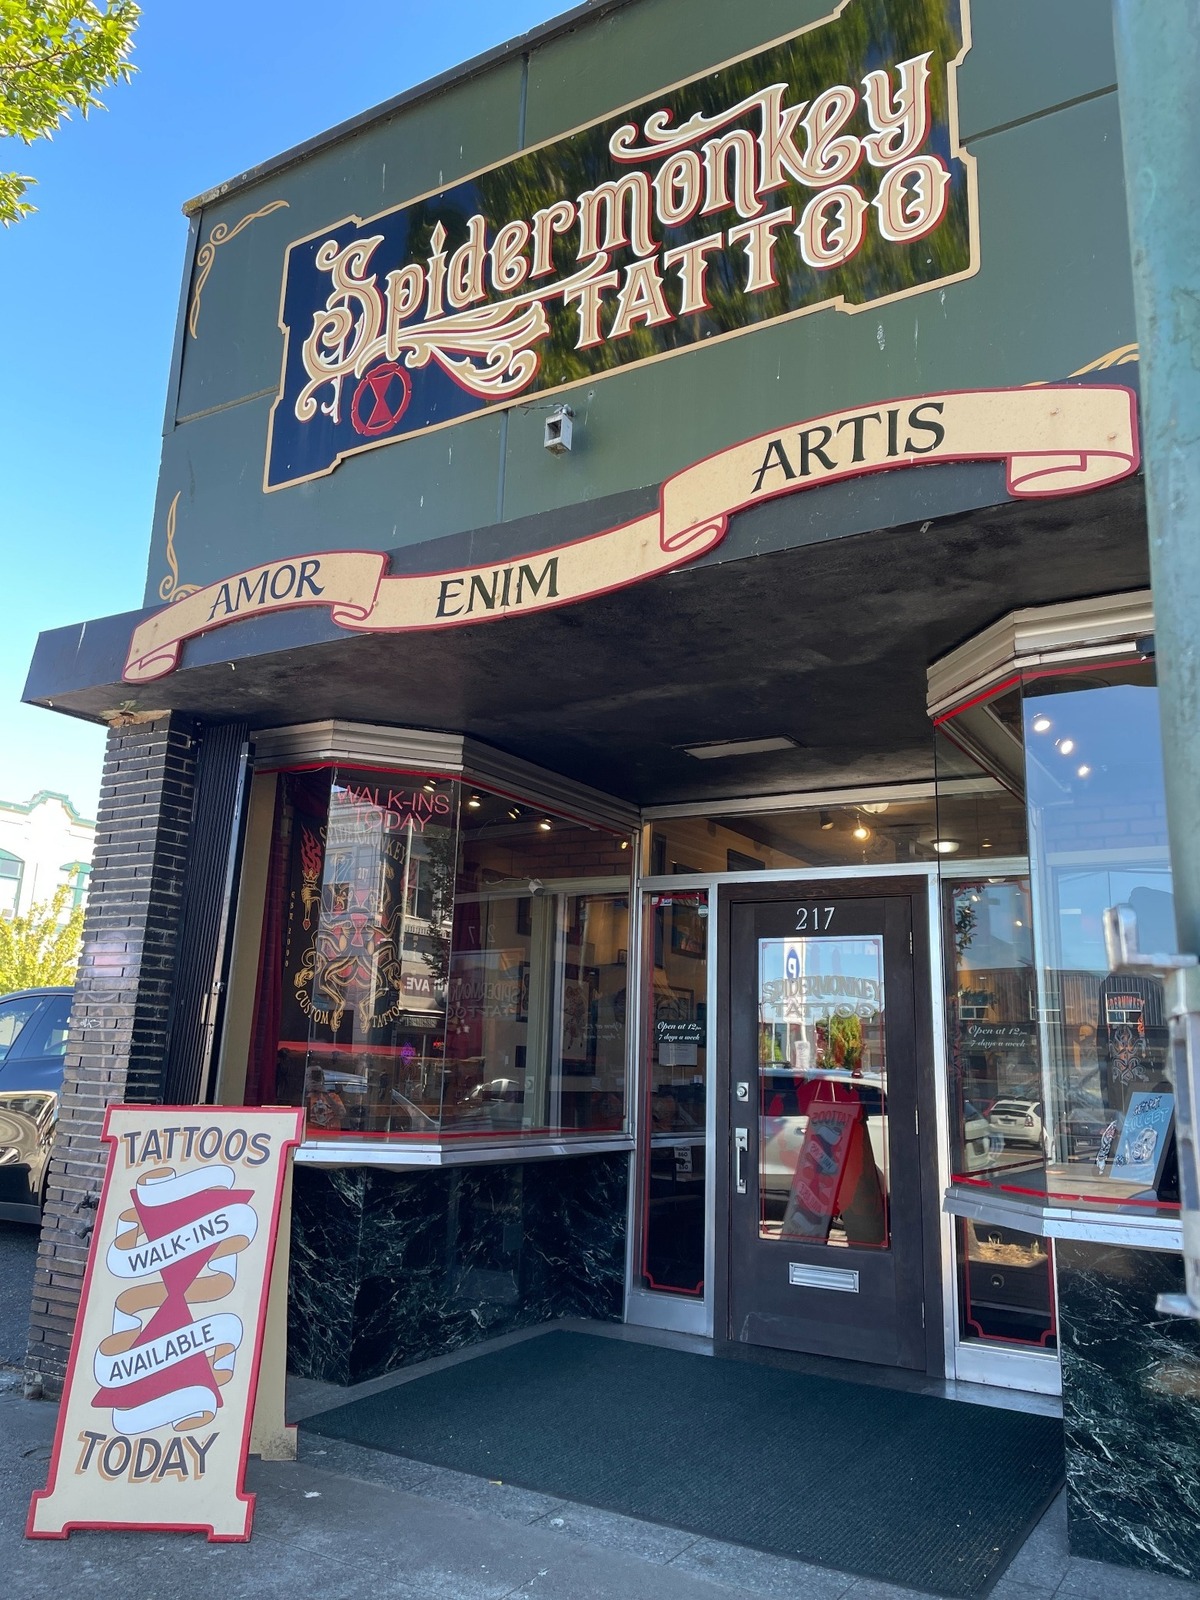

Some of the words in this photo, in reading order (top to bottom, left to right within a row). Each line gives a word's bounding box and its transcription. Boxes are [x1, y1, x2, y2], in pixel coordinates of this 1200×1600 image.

[293, 49, 936, 424] Spidermonkey
[563, 154, 952, 351] TATTOO
[206, 558, 326, 622] AMOR
[435, 556, 561, 619] ENIM
[750, 402, 946, 494] ARTIS
[336, 784, 450, 815] WALK-INS
[353, 807, 432, 833] TODAY
[795, 907, 836, 931] 217
[762, 974, 884, 1003] SPIDERMONKEY
[295, 989, 330, 1025] CUSTOM
[771, 1001, 876, 1019] TATTOO
[657, 1021, 677, 1033] Open
[663, 1033, 678, 1042] days
[684, 1033, 700, 1041] week
[968, 1025, 993, 1038] Open
[977, 1038, 996, 1049] days
[123, 1126, 271, 1169] TATTOOS
[128, 1213, 229, 1273] WALK-INS
[109, 1323, 215, 1382] AVAILABLE
[76, 1430, 220, 1484] TODAY
